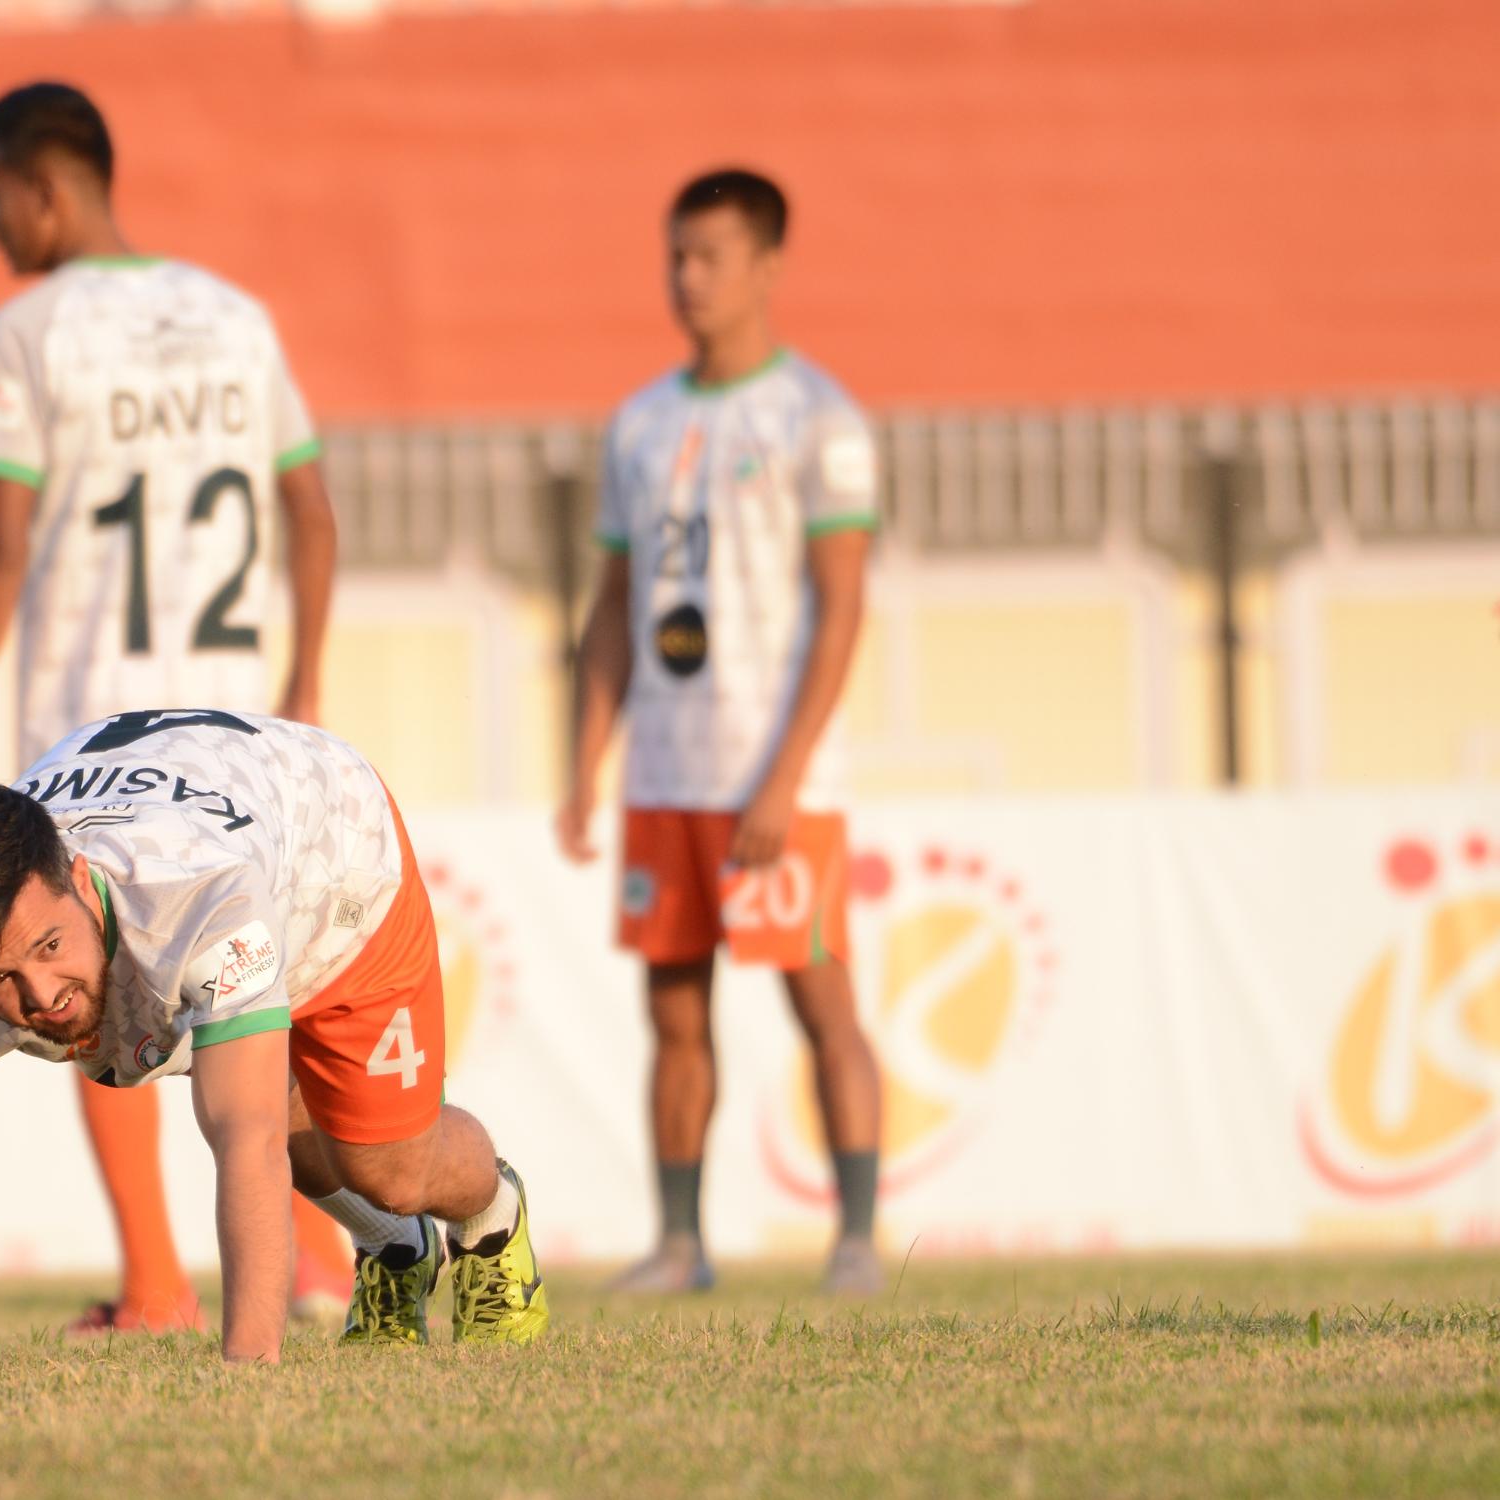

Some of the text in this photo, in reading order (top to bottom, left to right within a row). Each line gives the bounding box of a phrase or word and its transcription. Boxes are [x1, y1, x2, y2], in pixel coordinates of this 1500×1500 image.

[92, 469, 259, 653] 12
[655, 511, 709, 579] 20
[719, 853, 812, 928] 20
[241, 956, 274, 983] FITNESS
[365, 1006, 425, 1090] 4
